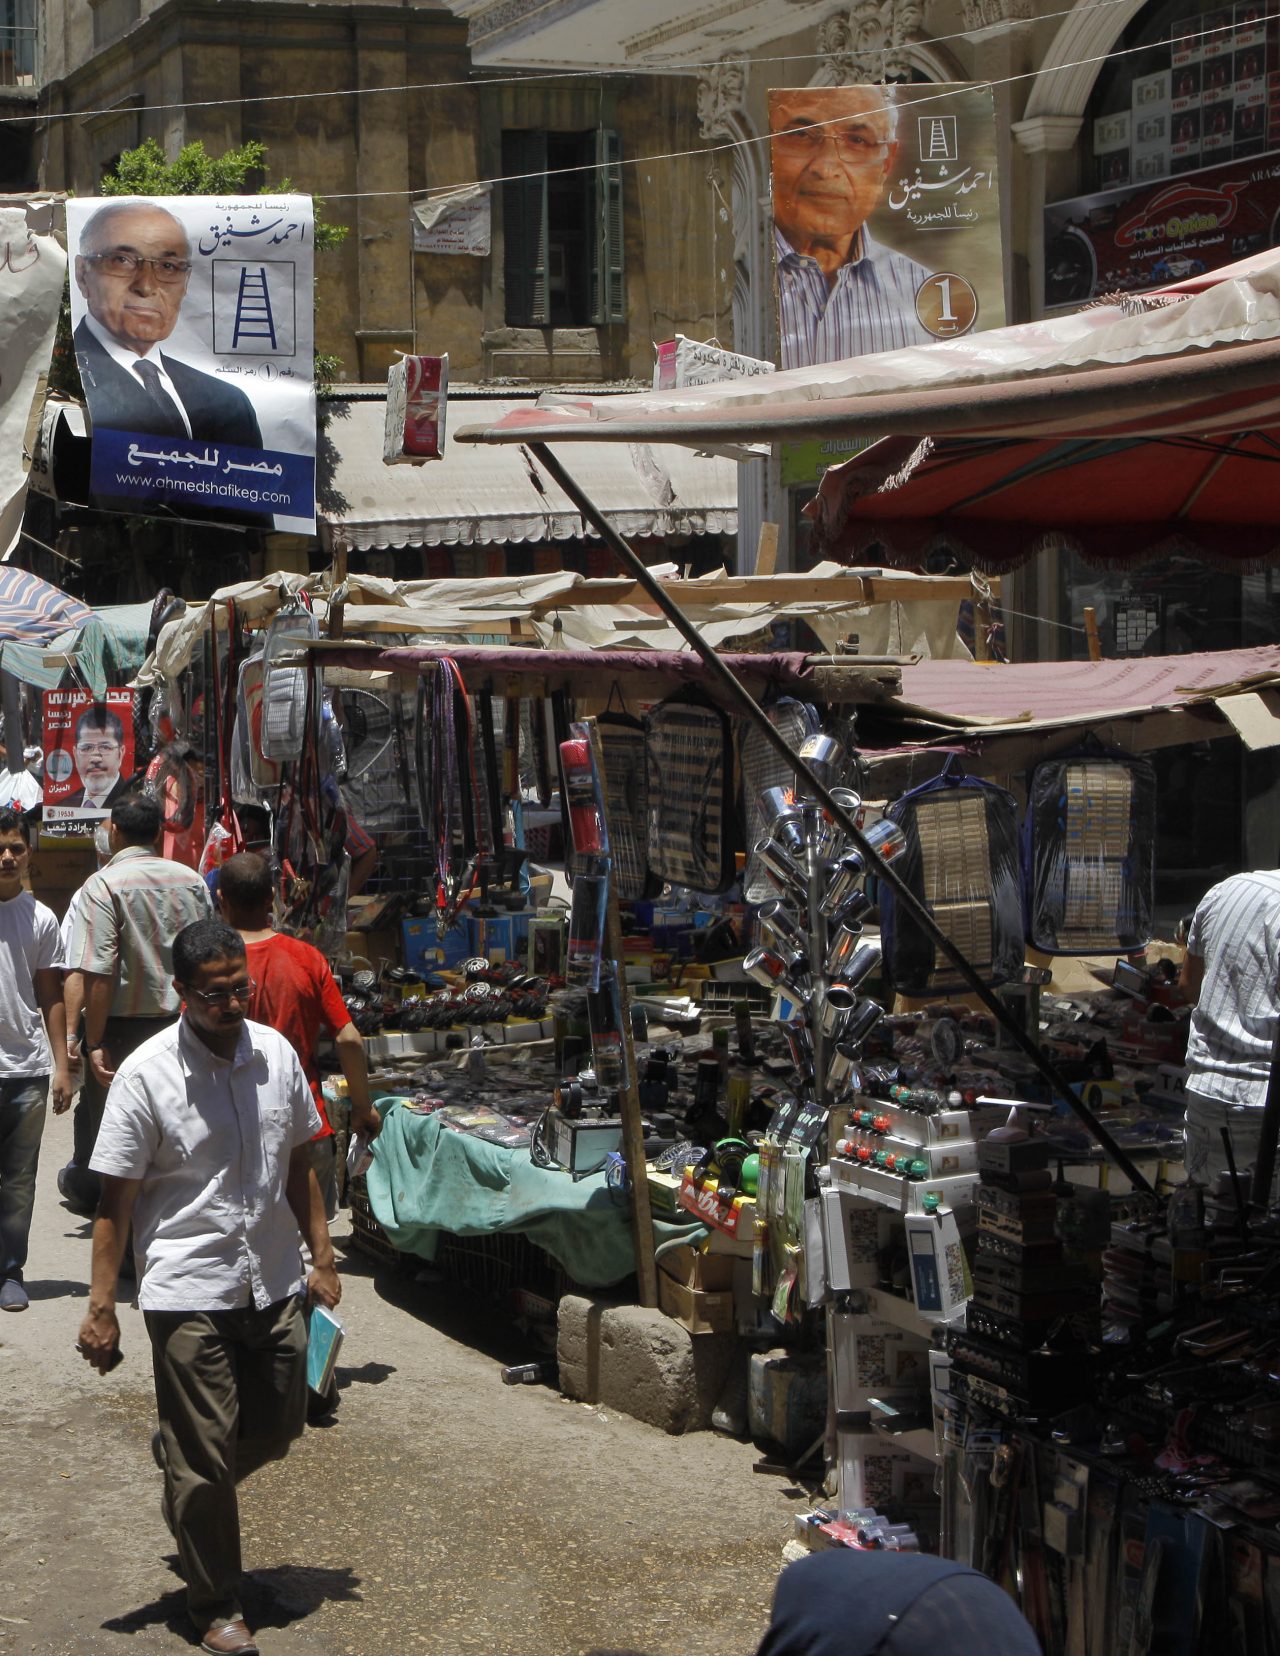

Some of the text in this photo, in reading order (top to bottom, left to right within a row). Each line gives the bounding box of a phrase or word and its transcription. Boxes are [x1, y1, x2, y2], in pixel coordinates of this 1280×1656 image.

[889, 165, 971, 209] شفيق
[215, 202, 264, 210] للجمهورية
[906, 207, 952, 224] للجمهورية
[199, 215, 283, 256] شفيق
[934, 278, 958, 321] 1
[215, 366, 242, 375] السلم
[244, 368, 257, 376] رمز
[279, 369, 295, 378] رقم
[127, 443, 283, 477] مصر للجميع
[116, 473, 291, 505] www.ahmedshafikeg.com
[48, 783, 71, 793] الميزان
[46, 821, 67, 834] شعب
